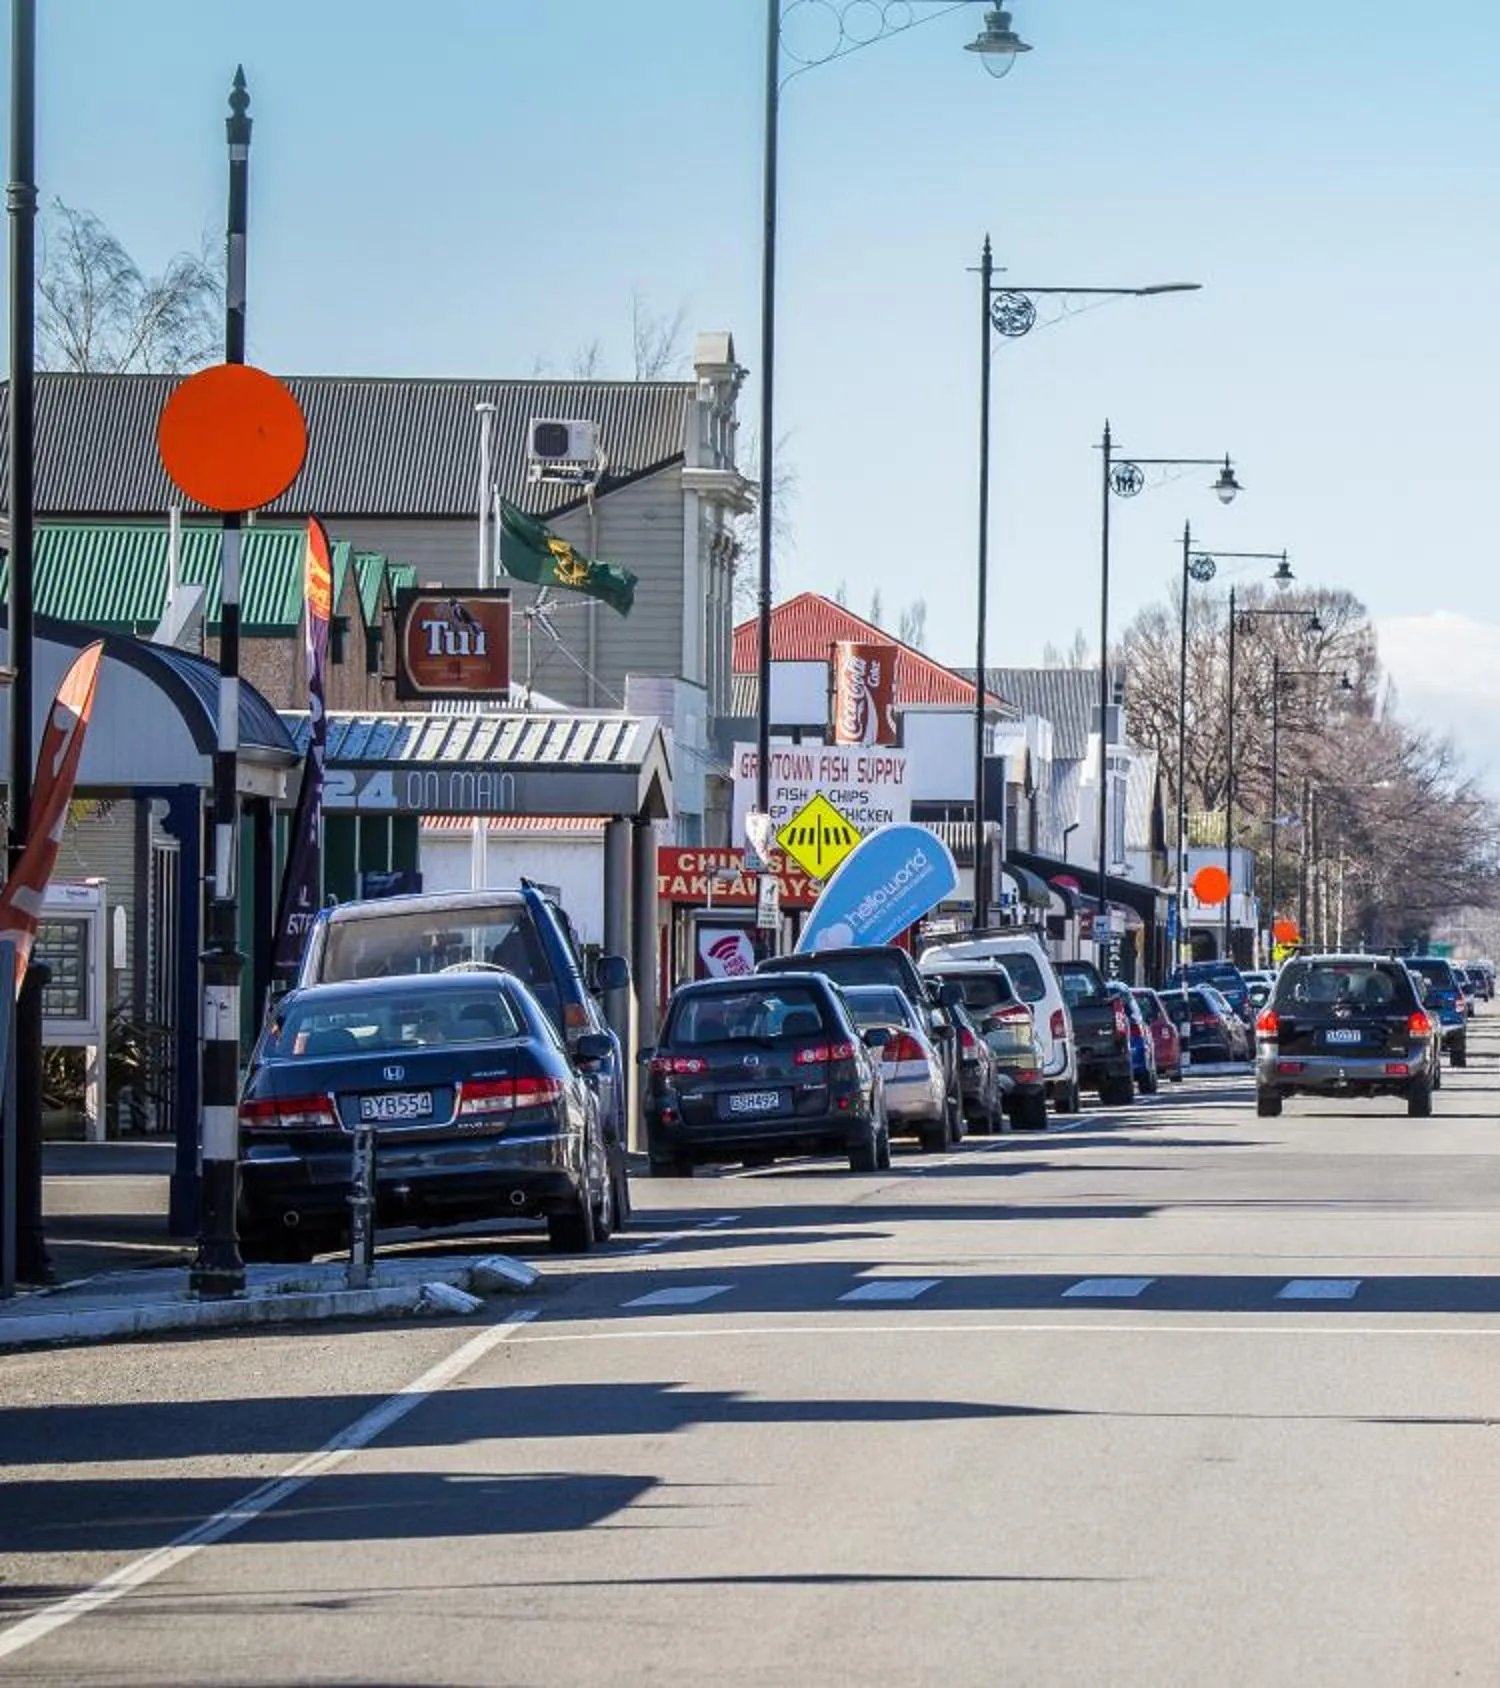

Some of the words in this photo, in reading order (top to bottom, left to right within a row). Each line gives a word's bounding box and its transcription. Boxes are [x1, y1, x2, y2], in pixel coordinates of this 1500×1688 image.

[421, 620, 487, 655] Tui
[741, 753, 814, 780] GRYTOWN
[819, 755, 850, 782] FISH
[857, 757, 906, 784] SUPPLY
[322, 769, 398, 808] 24
[777, 787, 807, 801] FISH
[829, 790, 869, 804] CHIPS
[677, 853, 800, 874] CHINSE
[361, 1094, 431, 1118] BYB554
